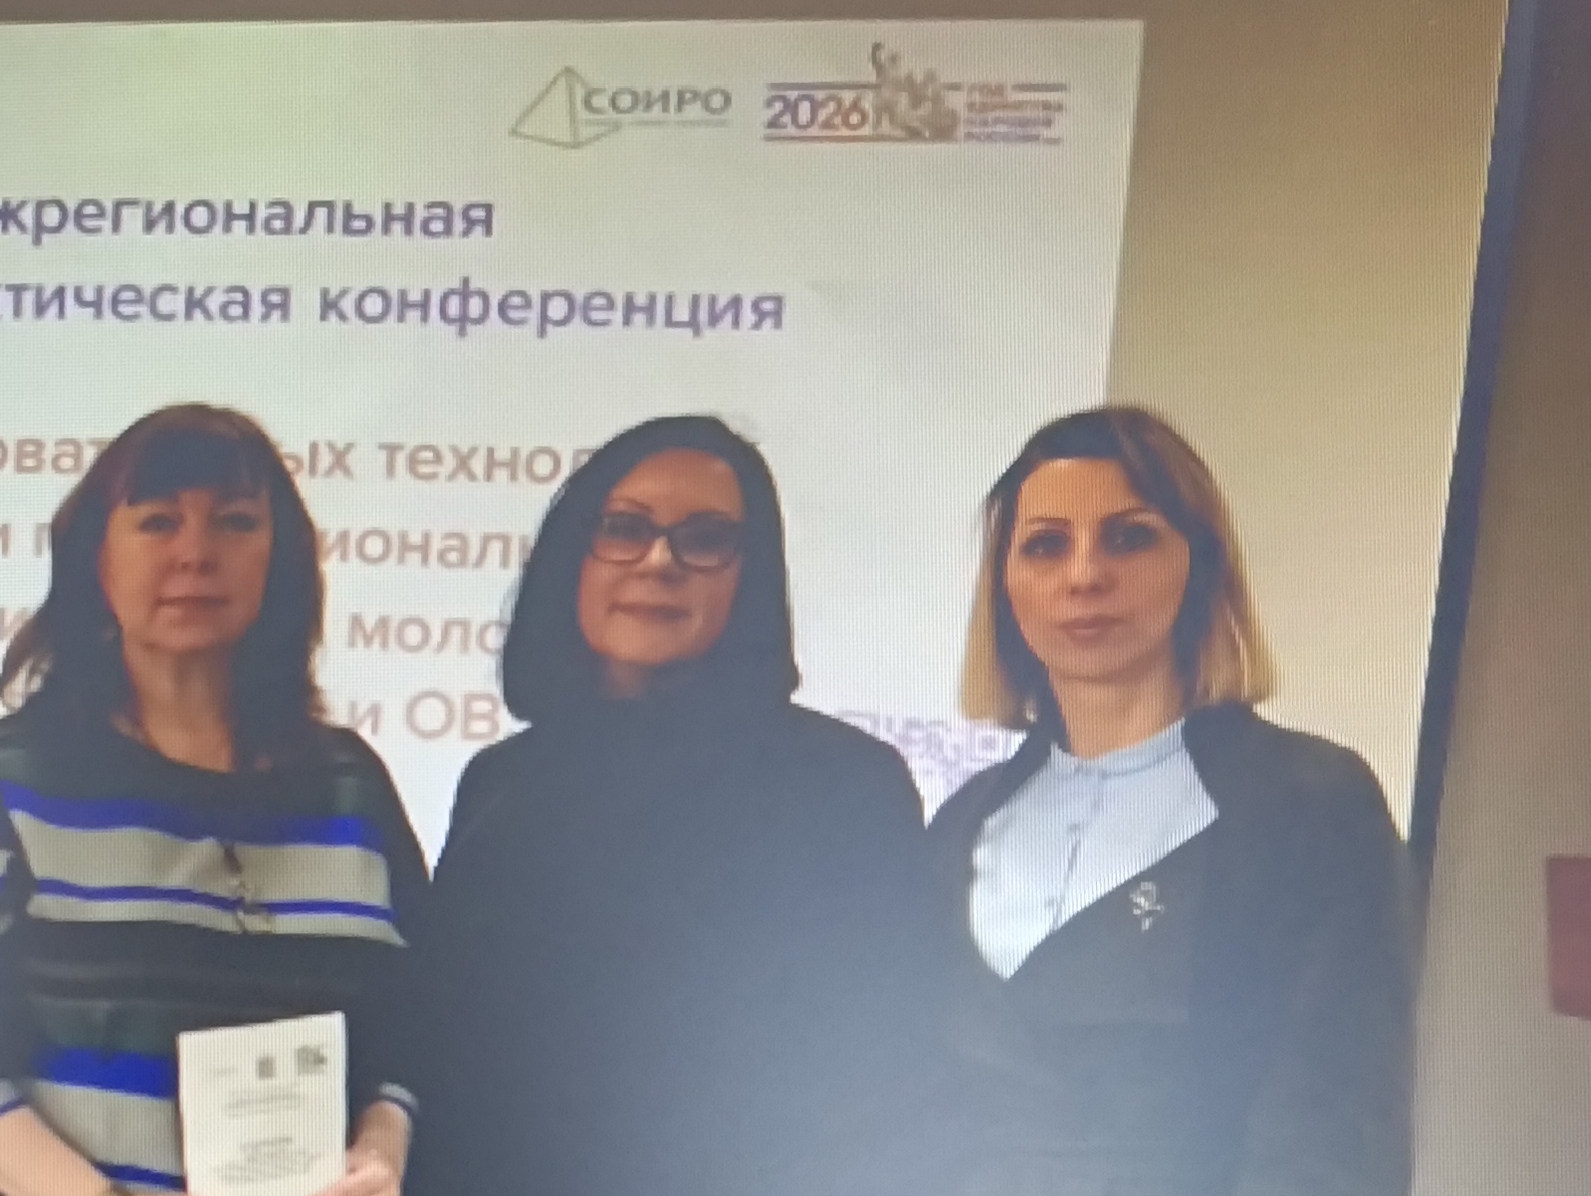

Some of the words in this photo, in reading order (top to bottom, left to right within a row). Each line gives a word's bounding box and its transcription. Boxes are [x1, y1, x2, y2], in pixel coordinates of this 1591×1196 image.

[583, 86, 733, 116] СОИРО
[765, 93, 868, 130] 2026
[318, 276, 786, 338] конференция
